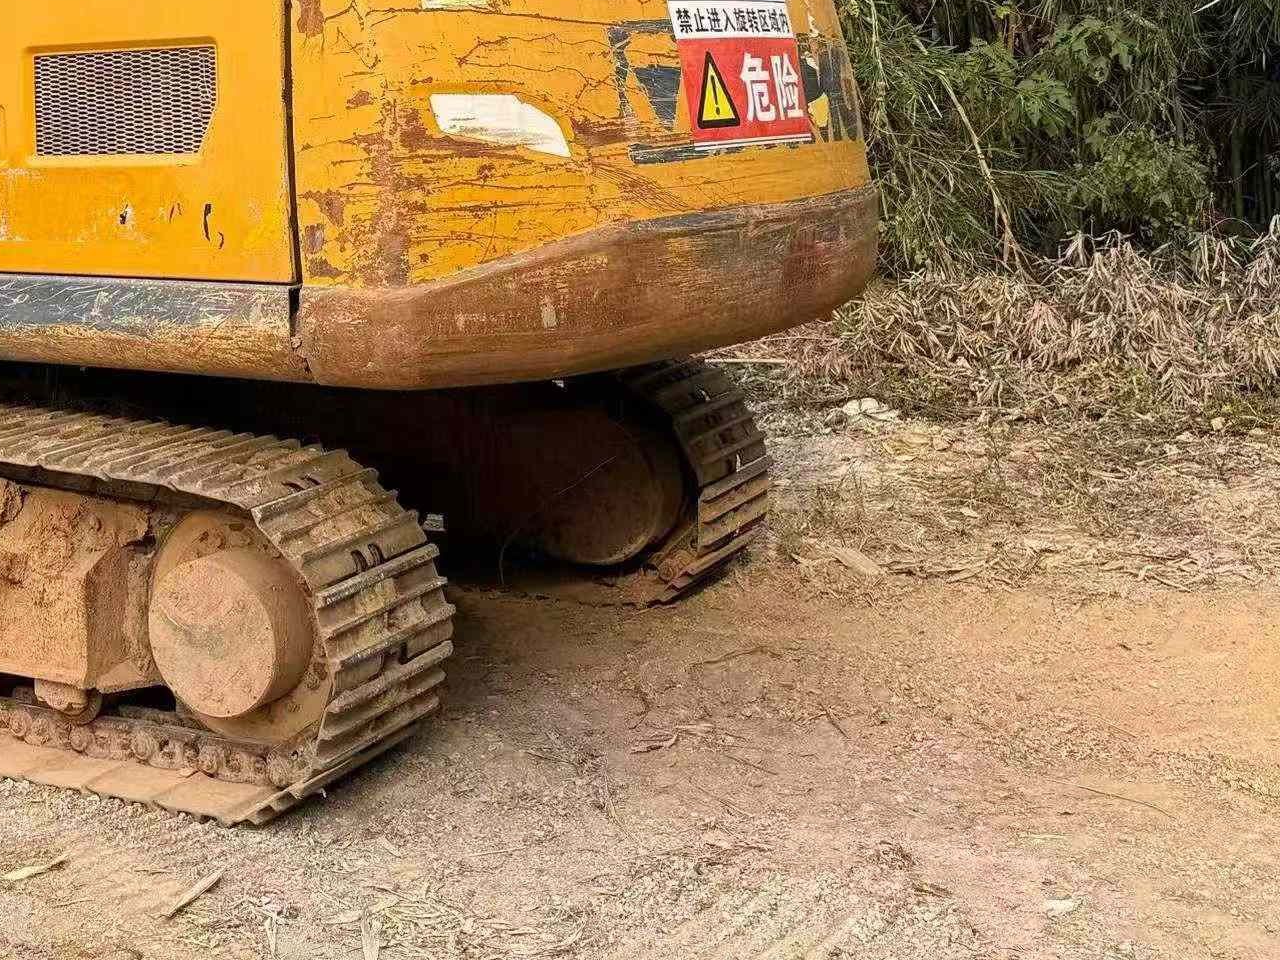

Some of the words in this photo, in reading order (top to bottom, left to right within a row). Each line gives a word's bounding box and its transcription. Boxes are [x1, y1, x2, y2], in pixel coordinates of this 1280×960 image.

[676, 7, 790, 34] 禁止进入旋转区域内
[740, 52, 804, 122] 危险
